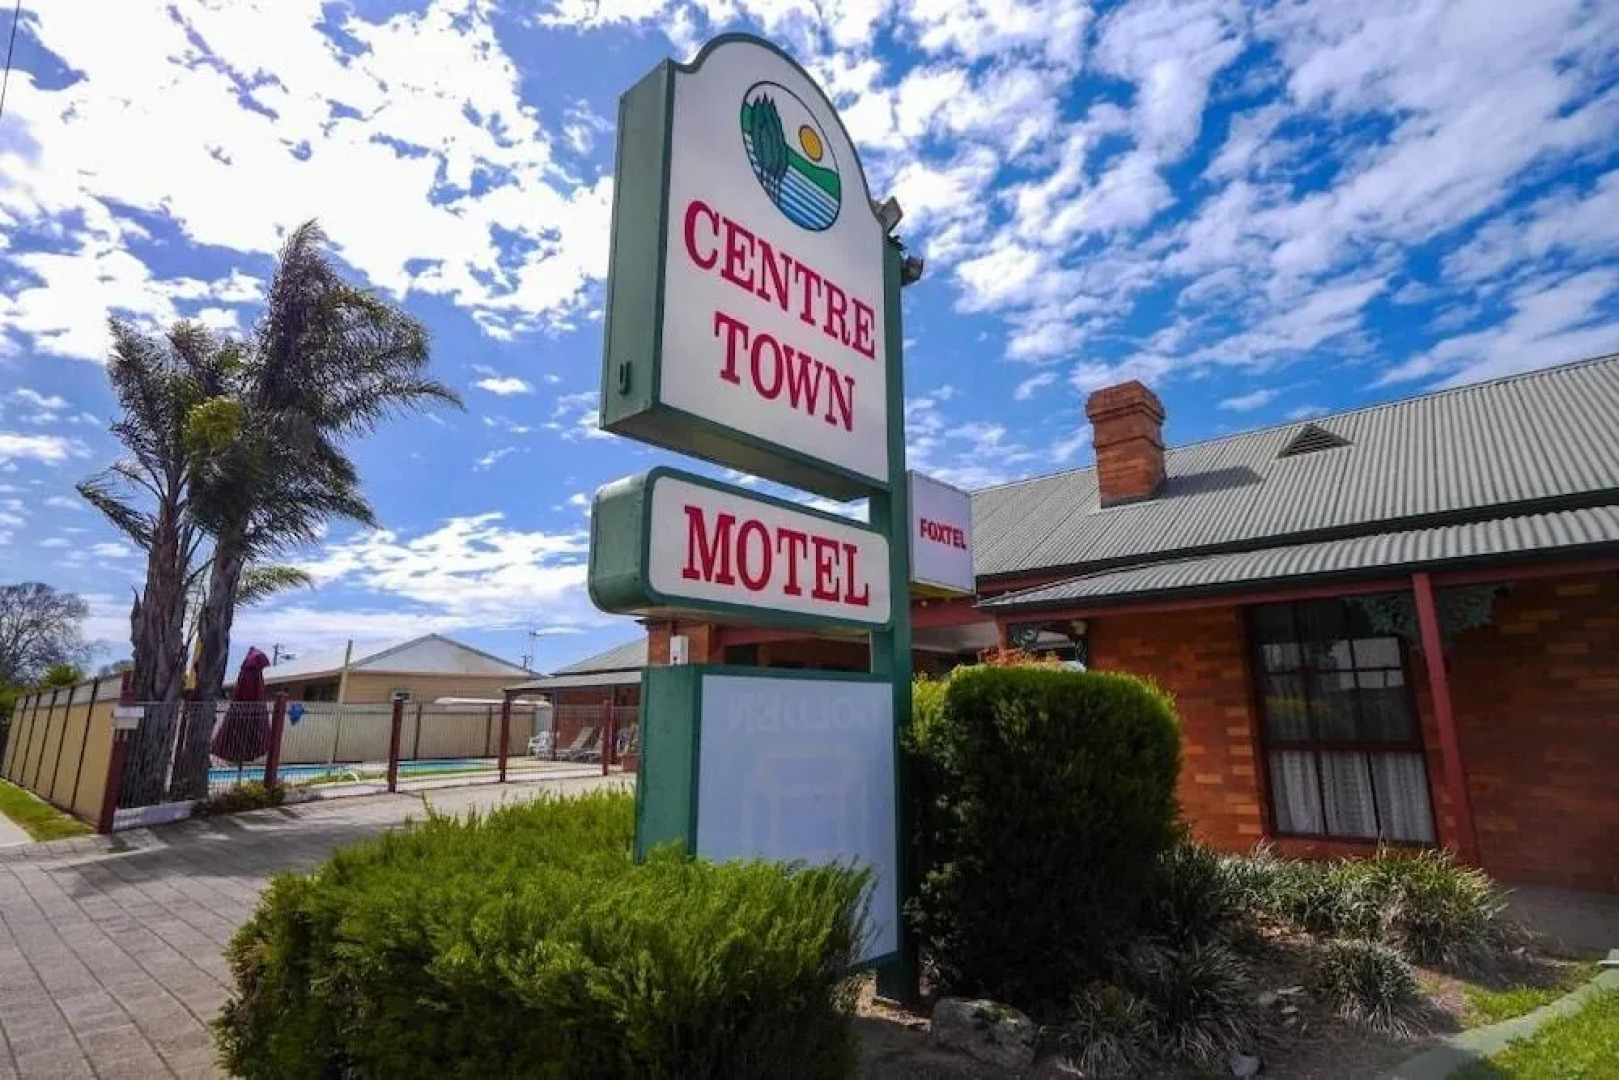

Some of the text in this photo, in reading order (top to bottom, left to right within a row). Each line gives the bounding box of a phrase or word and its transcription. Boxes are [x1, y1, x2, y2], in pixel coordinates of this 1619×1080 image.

[684, 200, 875, 360] CENTRE
[714, 311, 854, 432] TOWN
[682, 505, 869, 606] MOTEL
[920, 518, 967, 550] FOXTEL
